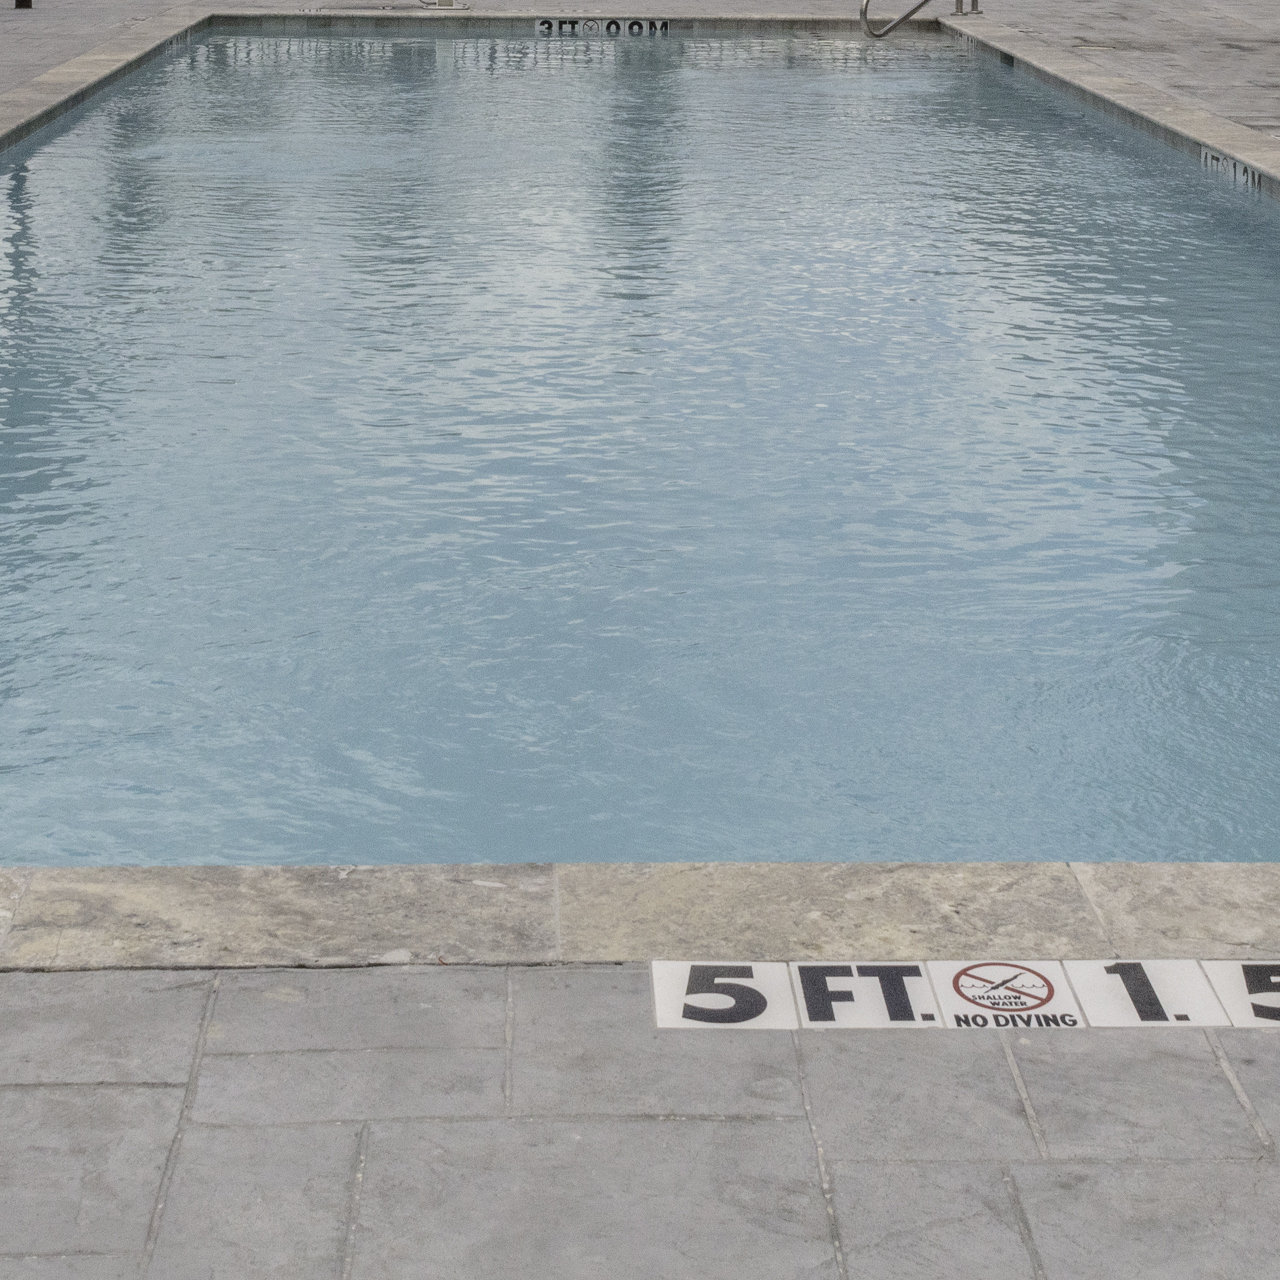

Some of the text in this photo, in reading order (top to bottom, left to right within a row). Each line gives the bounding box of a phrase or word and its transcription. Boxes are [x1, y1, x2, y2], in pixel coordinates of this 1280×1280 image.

[682, 965, 768, 1024] 5
[798, 965, 936, 1022] FT.
[954, 1013, 1078, 1028] NO DIVING
